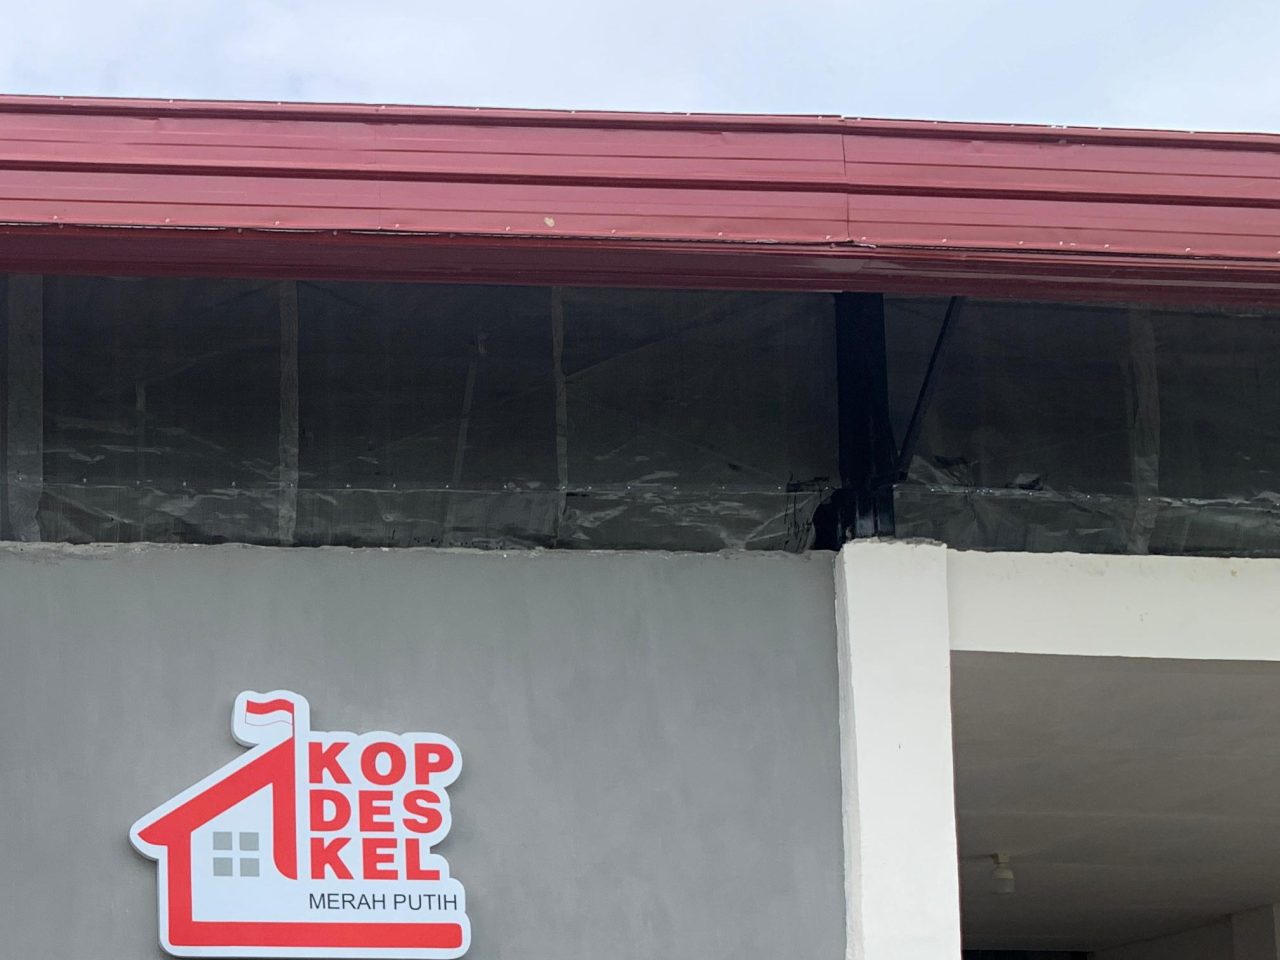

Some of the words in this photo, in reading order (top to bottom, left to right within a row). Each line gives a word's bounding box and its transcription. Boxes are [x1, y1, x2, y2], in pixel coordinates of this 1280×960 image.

[309, 741, 456, 786] KOP
[309, 789, 444, 833] DES
[309, 837, 441, 881] KEL
[308, 892, 387, 910] MERAH
[393, 893, 459, 911] PUTIH
